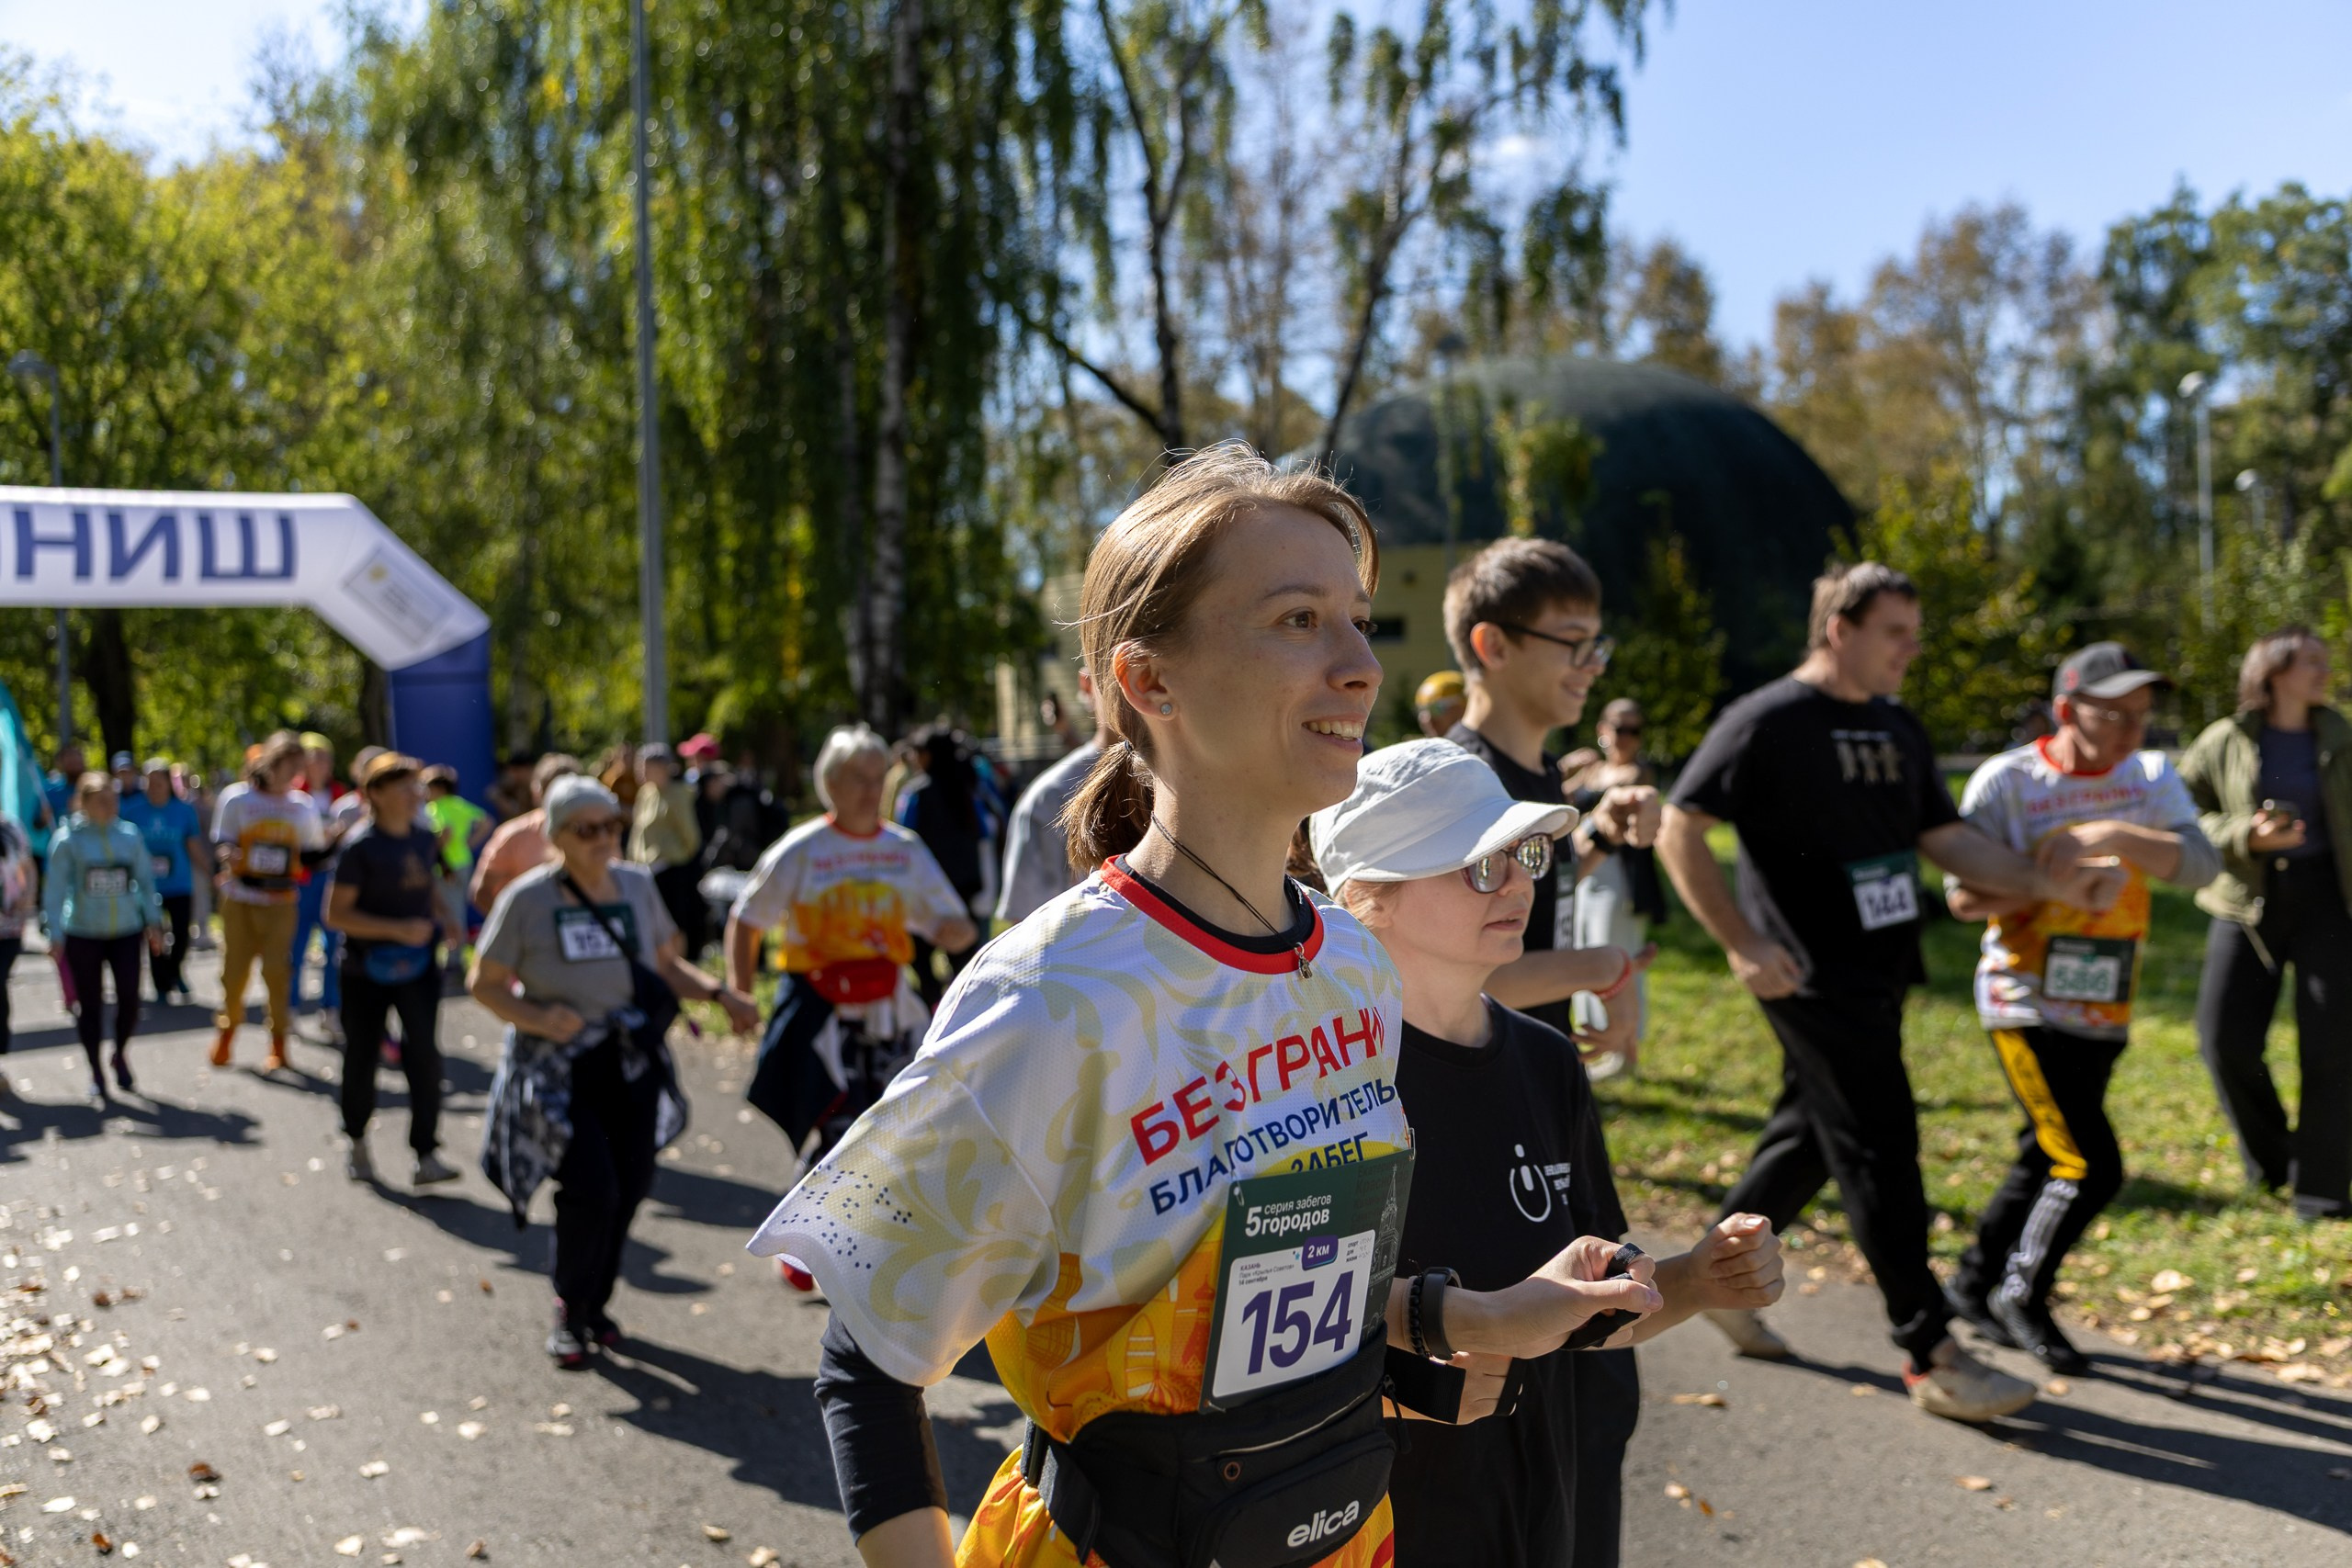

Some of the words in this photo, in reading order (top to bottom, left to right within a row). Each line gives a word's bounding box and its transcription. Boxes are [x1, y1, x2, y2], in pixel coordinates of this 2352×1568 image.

[1149, 1078, 1396, 1216] БЛАГОТВОРИТЕЛЬ
[1264, 1201, 1295, 1215] серия
[1295, 1194, 1332, 1210] забегов
[1240, 1262, 1261, 1271] КАЗАНЬ
[1307, 1245, 1316, 1258] 2
[1241, 1269, 1354, 1376] 154
[1287, 1499, 1360, 1548] elica
